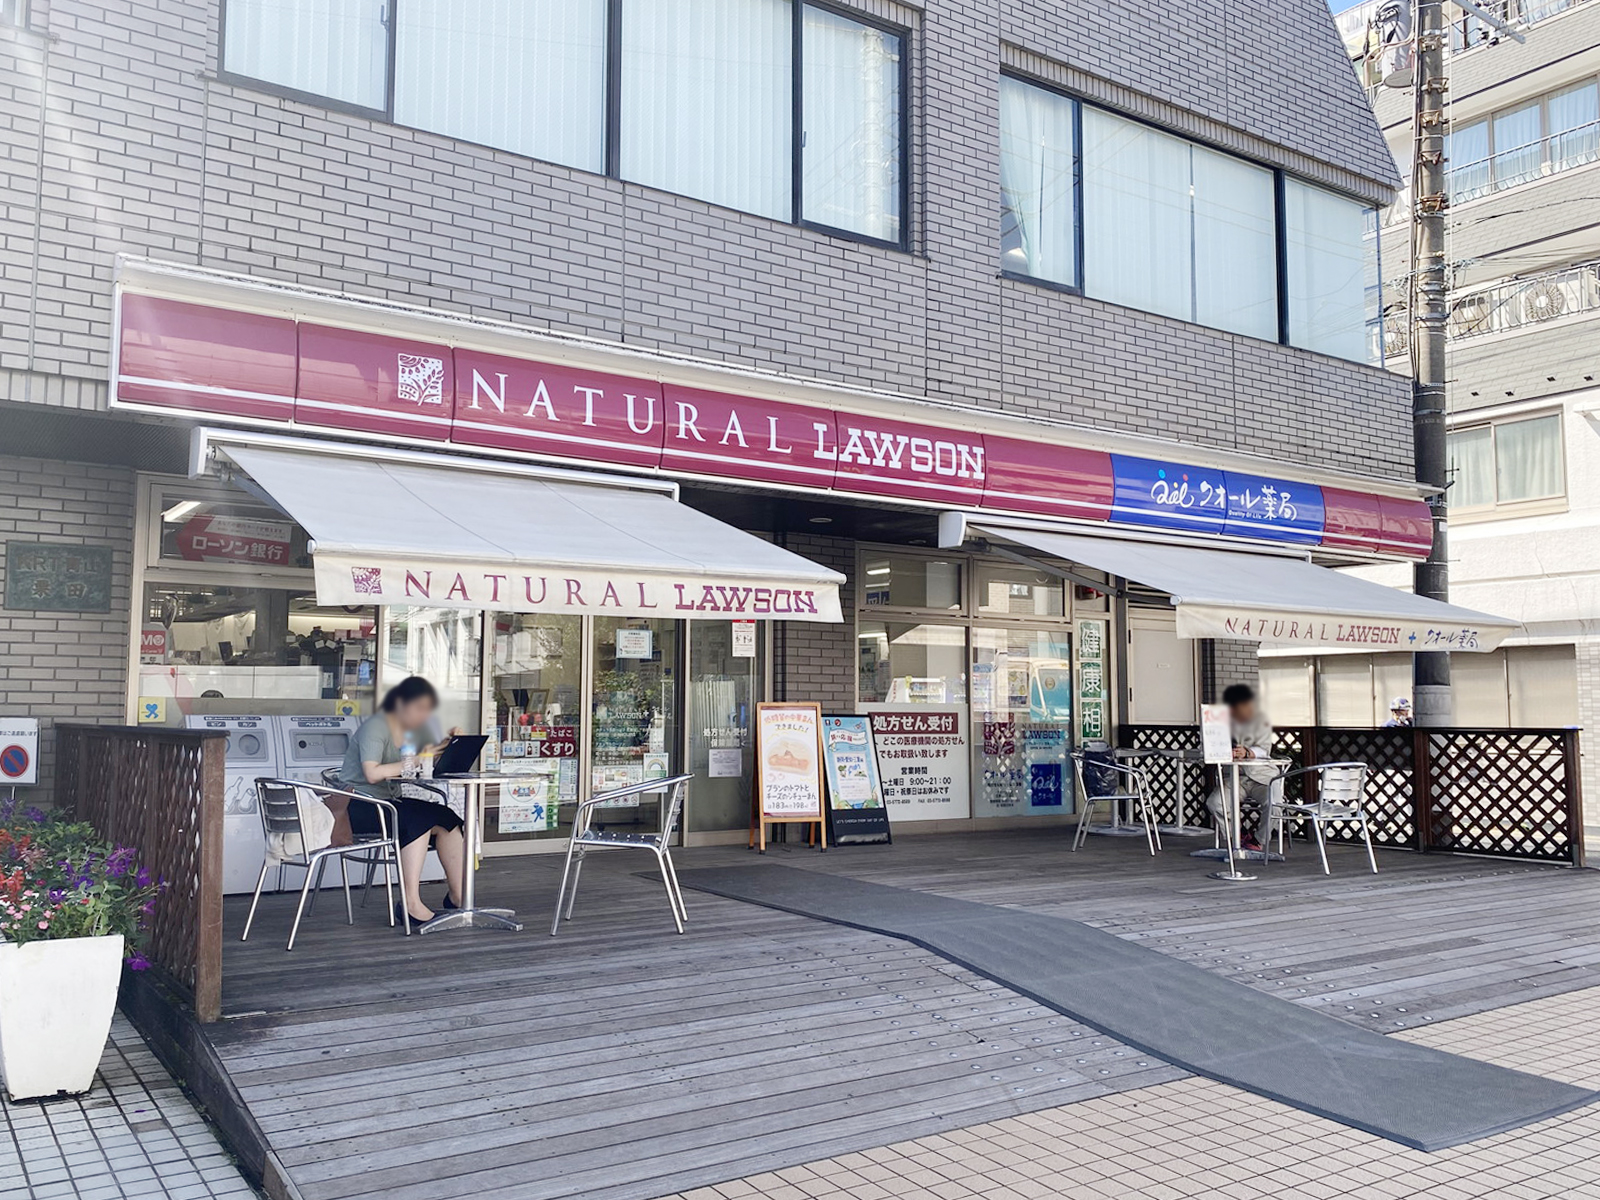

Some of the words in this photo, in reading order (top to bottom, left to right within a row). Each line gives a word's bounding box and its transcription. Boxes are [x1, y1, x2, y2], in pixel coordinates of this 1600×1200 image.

[469, 369, 792, 455] NATURAL
[813, 423, 986, 480] LAWSON
[1200, 481, 1297, 521] クオール薬局
[192, 535, 283, 560] ローソン銀行
[404, 569, 659, 608] NATURAL
[674, 584, 818, 614] LAWSON
[1225, 617, 1330, 640] NATURAL
[1336, 624, 1401, 644] LAWSON
[550, 729, 573, 737] たばこ
[873, 715, 954, 731] 処方せん受付
[1022, 730, 1061, 739] LAWSON
[541, 742, 574, 755] くすり
[901, 766, 928, 775] 営業時間
